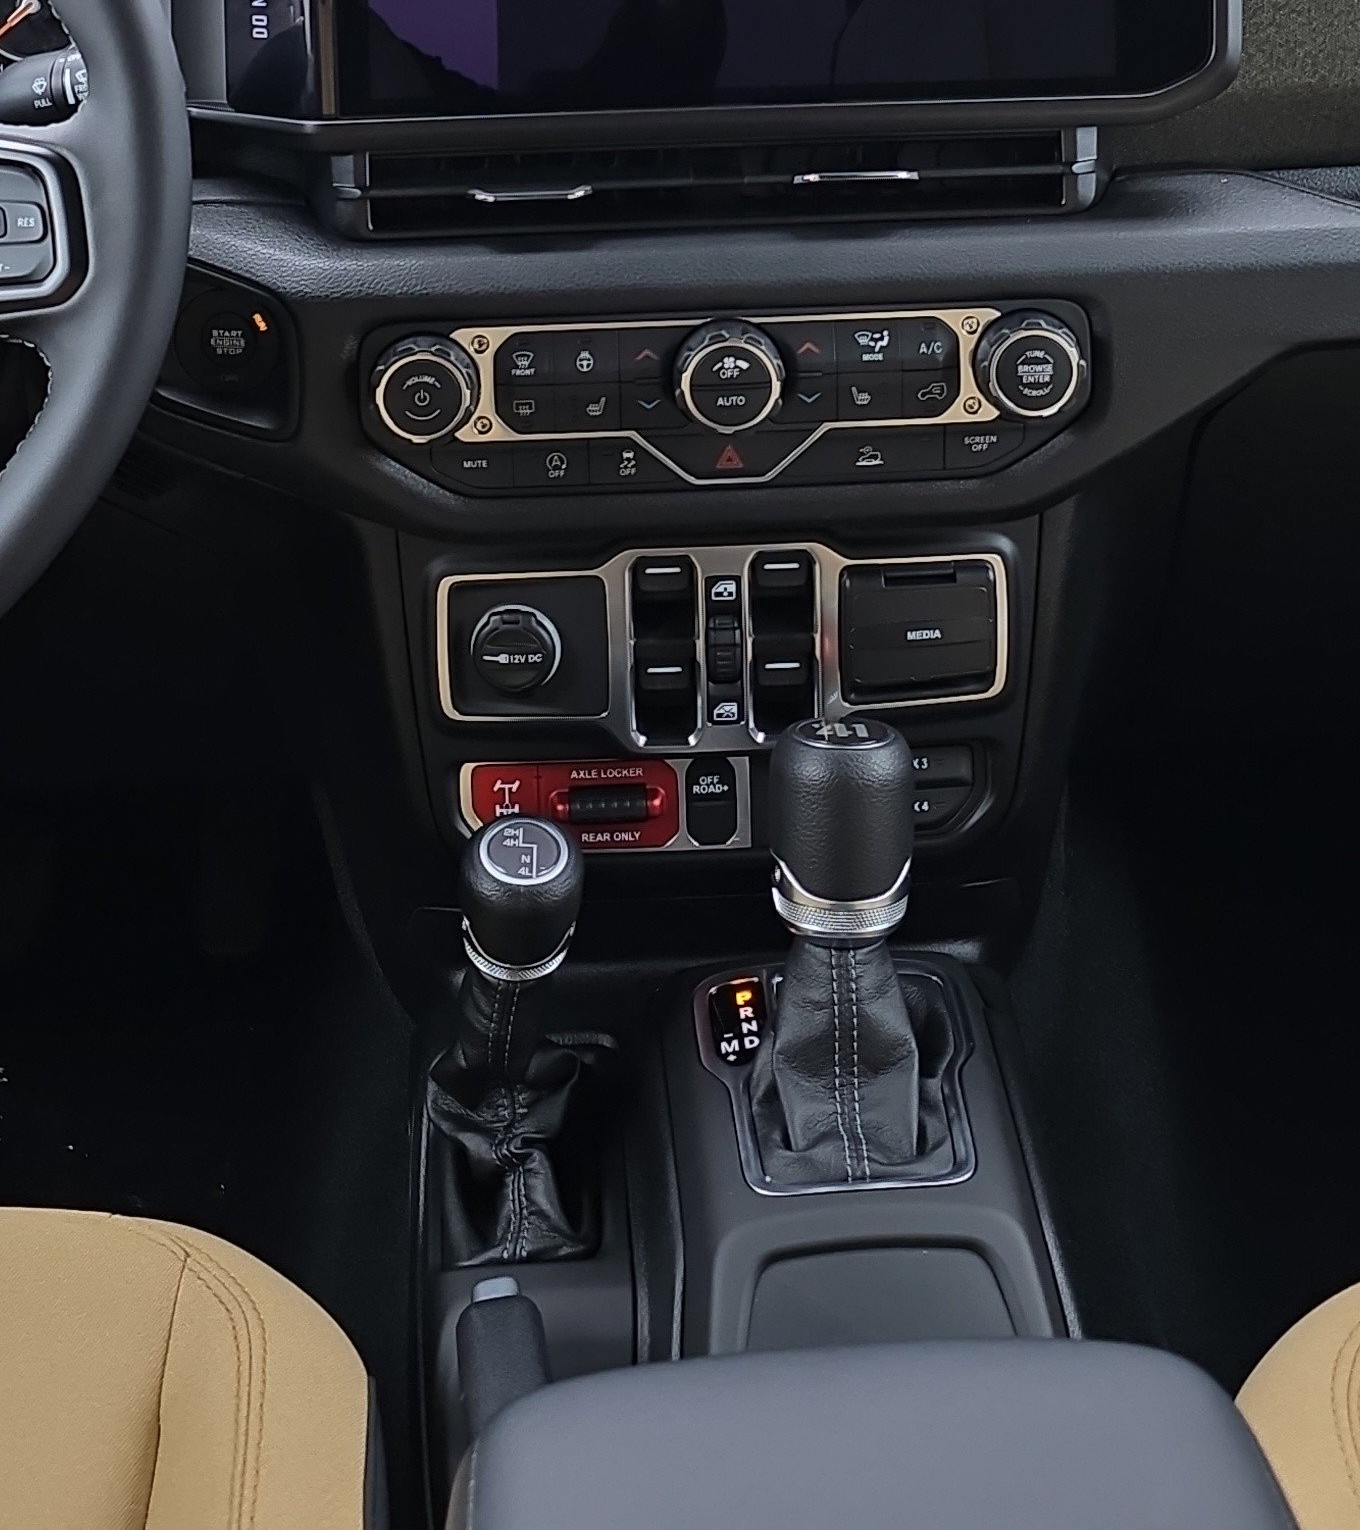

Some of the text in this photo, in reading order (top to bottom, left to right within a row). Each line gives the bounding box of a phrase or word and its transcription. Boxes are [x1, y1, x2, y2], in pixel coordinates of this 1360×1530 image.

[251, 14, 268, 39] DO
[33, 97, 53, 109] PULL
[17, 217, 36, 228] RES
[211, 337, 246, 347] ENGINE
[919, 341, 943, 355] A/C
[862, 353, 884, 361] MODE
[1025, 350, 1046, 358] TUNE
[511, 368, 536, 376] FRONT
[1017, 364, 1053, 373] BROWSE
[719, 369, 740, 379] OFF
[1022, 375, 1051, 383] ENTER
[406, 375, 435, 384] VOLUME
[1022, 388, 1050, 397] SCROLL
[716, 395, 745, 407] AUTO
[964, 435, 998, 445] SCREEN
[971, 443, 989, 452] OFF
[463, 459, 489, 468] MUTE
[548, 470, 566, 478] OFF
[619, 468, 637, 476] OFF
[906, 627, 942, 641] MEDIA
[510, 653, 543, 663] 12V DC
[570, 767, 643, 780] AXLE LOCKER
[699, 775, 720, 785] OFF
[921, 801, 930, 811] 4
[503, 827, 520, 837] 2H
[581, 830, 642, 843] REAR ONLY
[502, 838, 520, 847] 4H
[521, 854, 531, 864] N
[517, 867, 533, 876] 4L
[735, 991, 752, 1006] P
[738, 1006, 755, 1020] R
[740, 1020, 759, 1035] N
[720, 1038, 740, 1055] M
[744, 1035, 761, 1050] D
